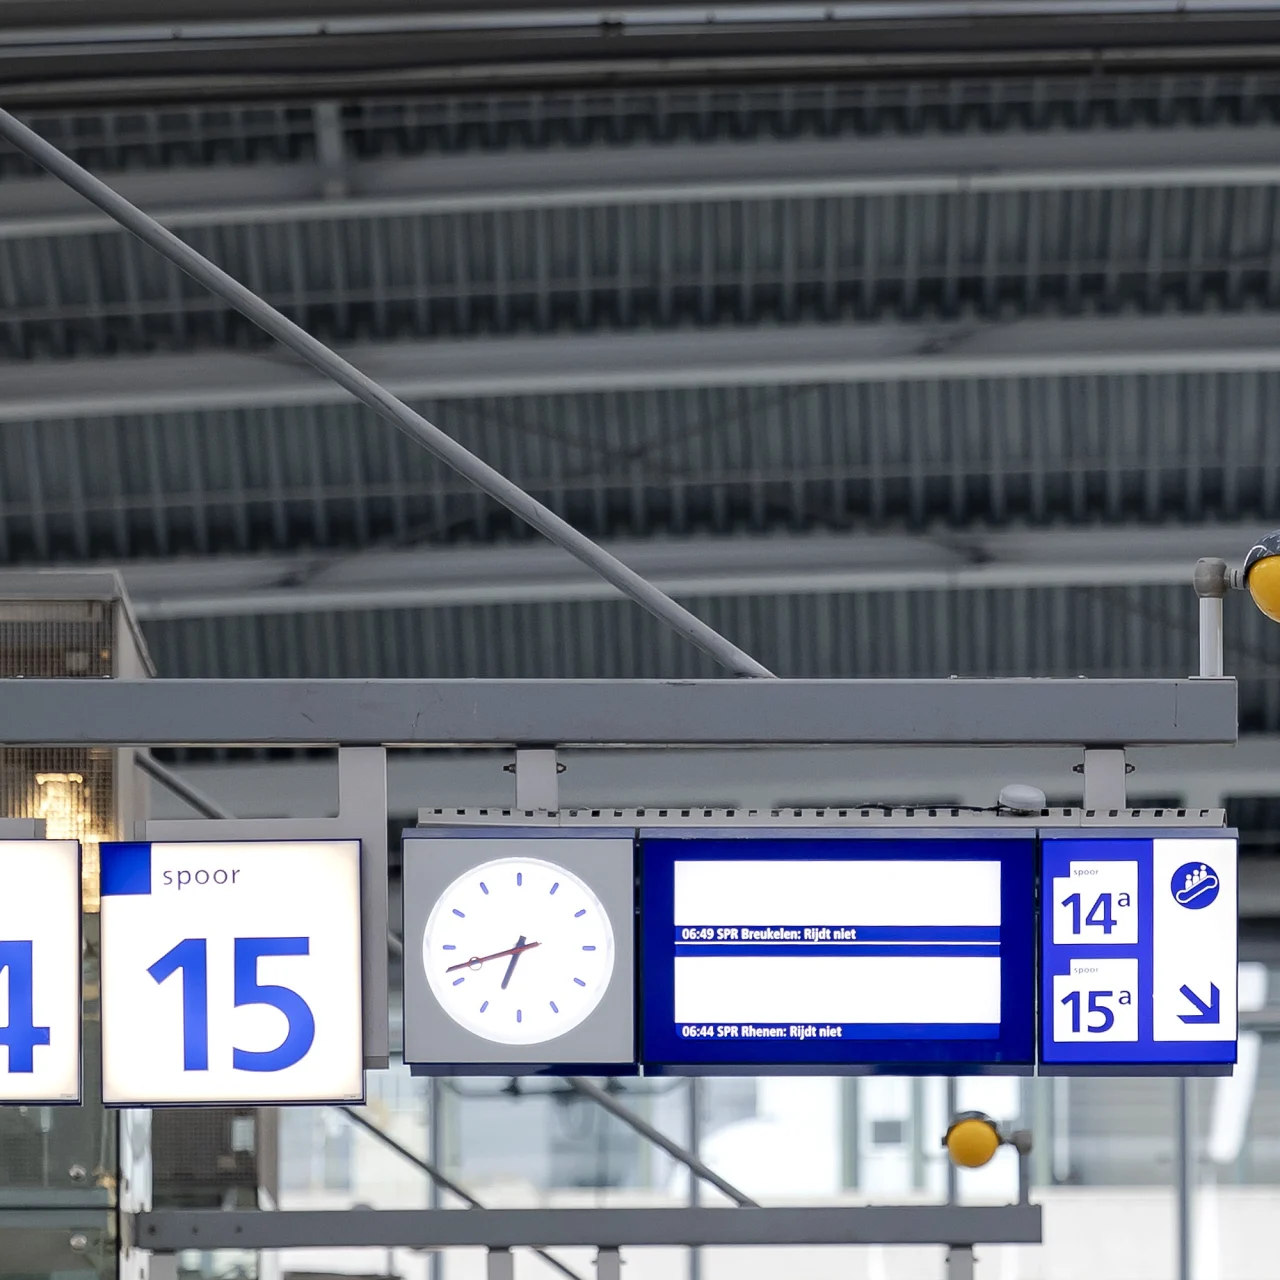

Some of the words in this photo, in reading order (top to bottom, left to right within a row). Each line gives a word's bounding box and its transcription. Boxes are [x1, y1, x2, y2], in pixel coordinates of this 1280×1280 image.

[162, 865, 241, 890] spoor
[1073, 868, 1099, 876] spoor
[681, 927, 715, 940] 06:49
[717, 927, 739, 940] SPR
[741, 927, 802, 940] Breukelen:
[804, 927, 831, 942] Rijdt
[833, 927, 857, 940] niet
[1073, 966, 1099, 974] spoor
[146, 936, 316, 1073] 15
[681, 1025, 715, 1038] 06:44
[717, 1025, 739, 1038] SPR
[741, 1025, 787, 1038] Rhenen:
[789, 1025, 817, 1040] Rijdt
[819, 1025, 843, 1038] niet
